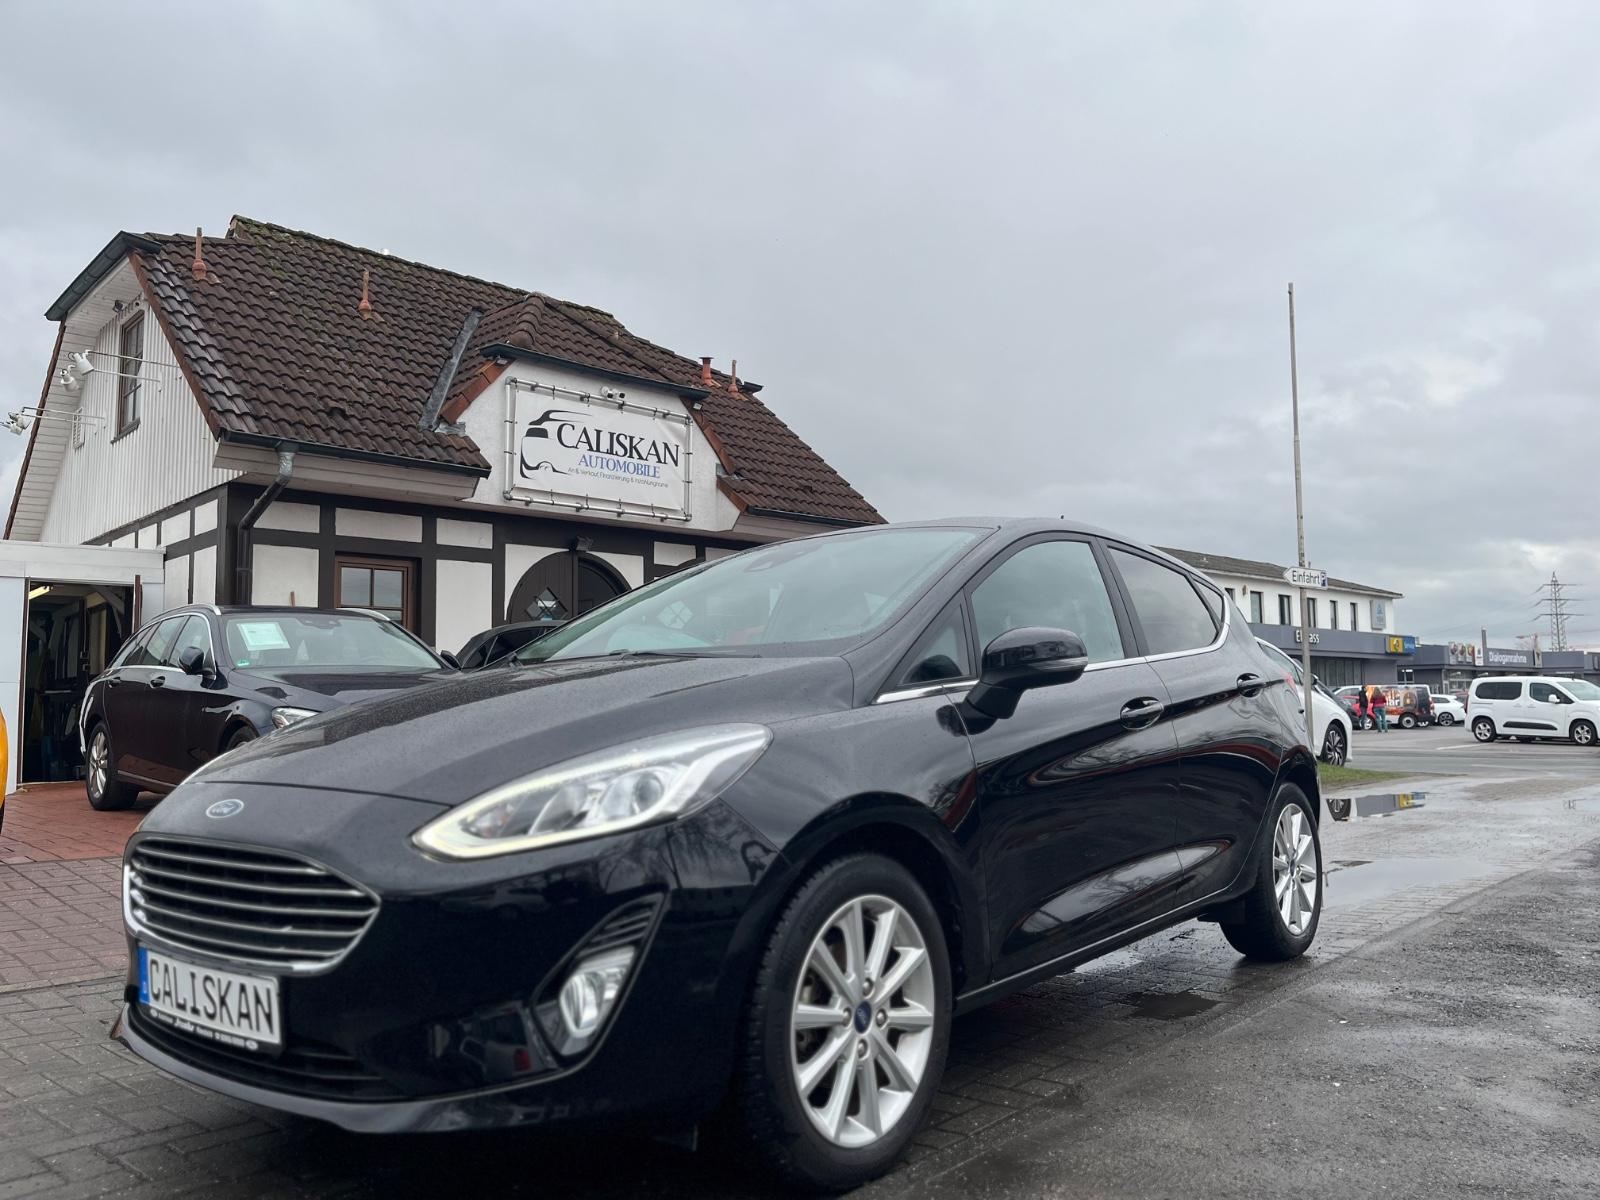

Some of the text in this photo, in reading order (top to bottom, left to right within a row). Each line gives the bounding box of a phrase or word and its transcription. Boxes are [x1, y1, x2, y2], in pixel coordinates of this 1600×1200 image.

[556, 422, 680, 467] CALISKAN
[578, 453, 661, 479] AUTOMOBILE
[1292, 570, 1320, 585] Einfahrt
[149, 958, 275, 1036] CALISKAN
